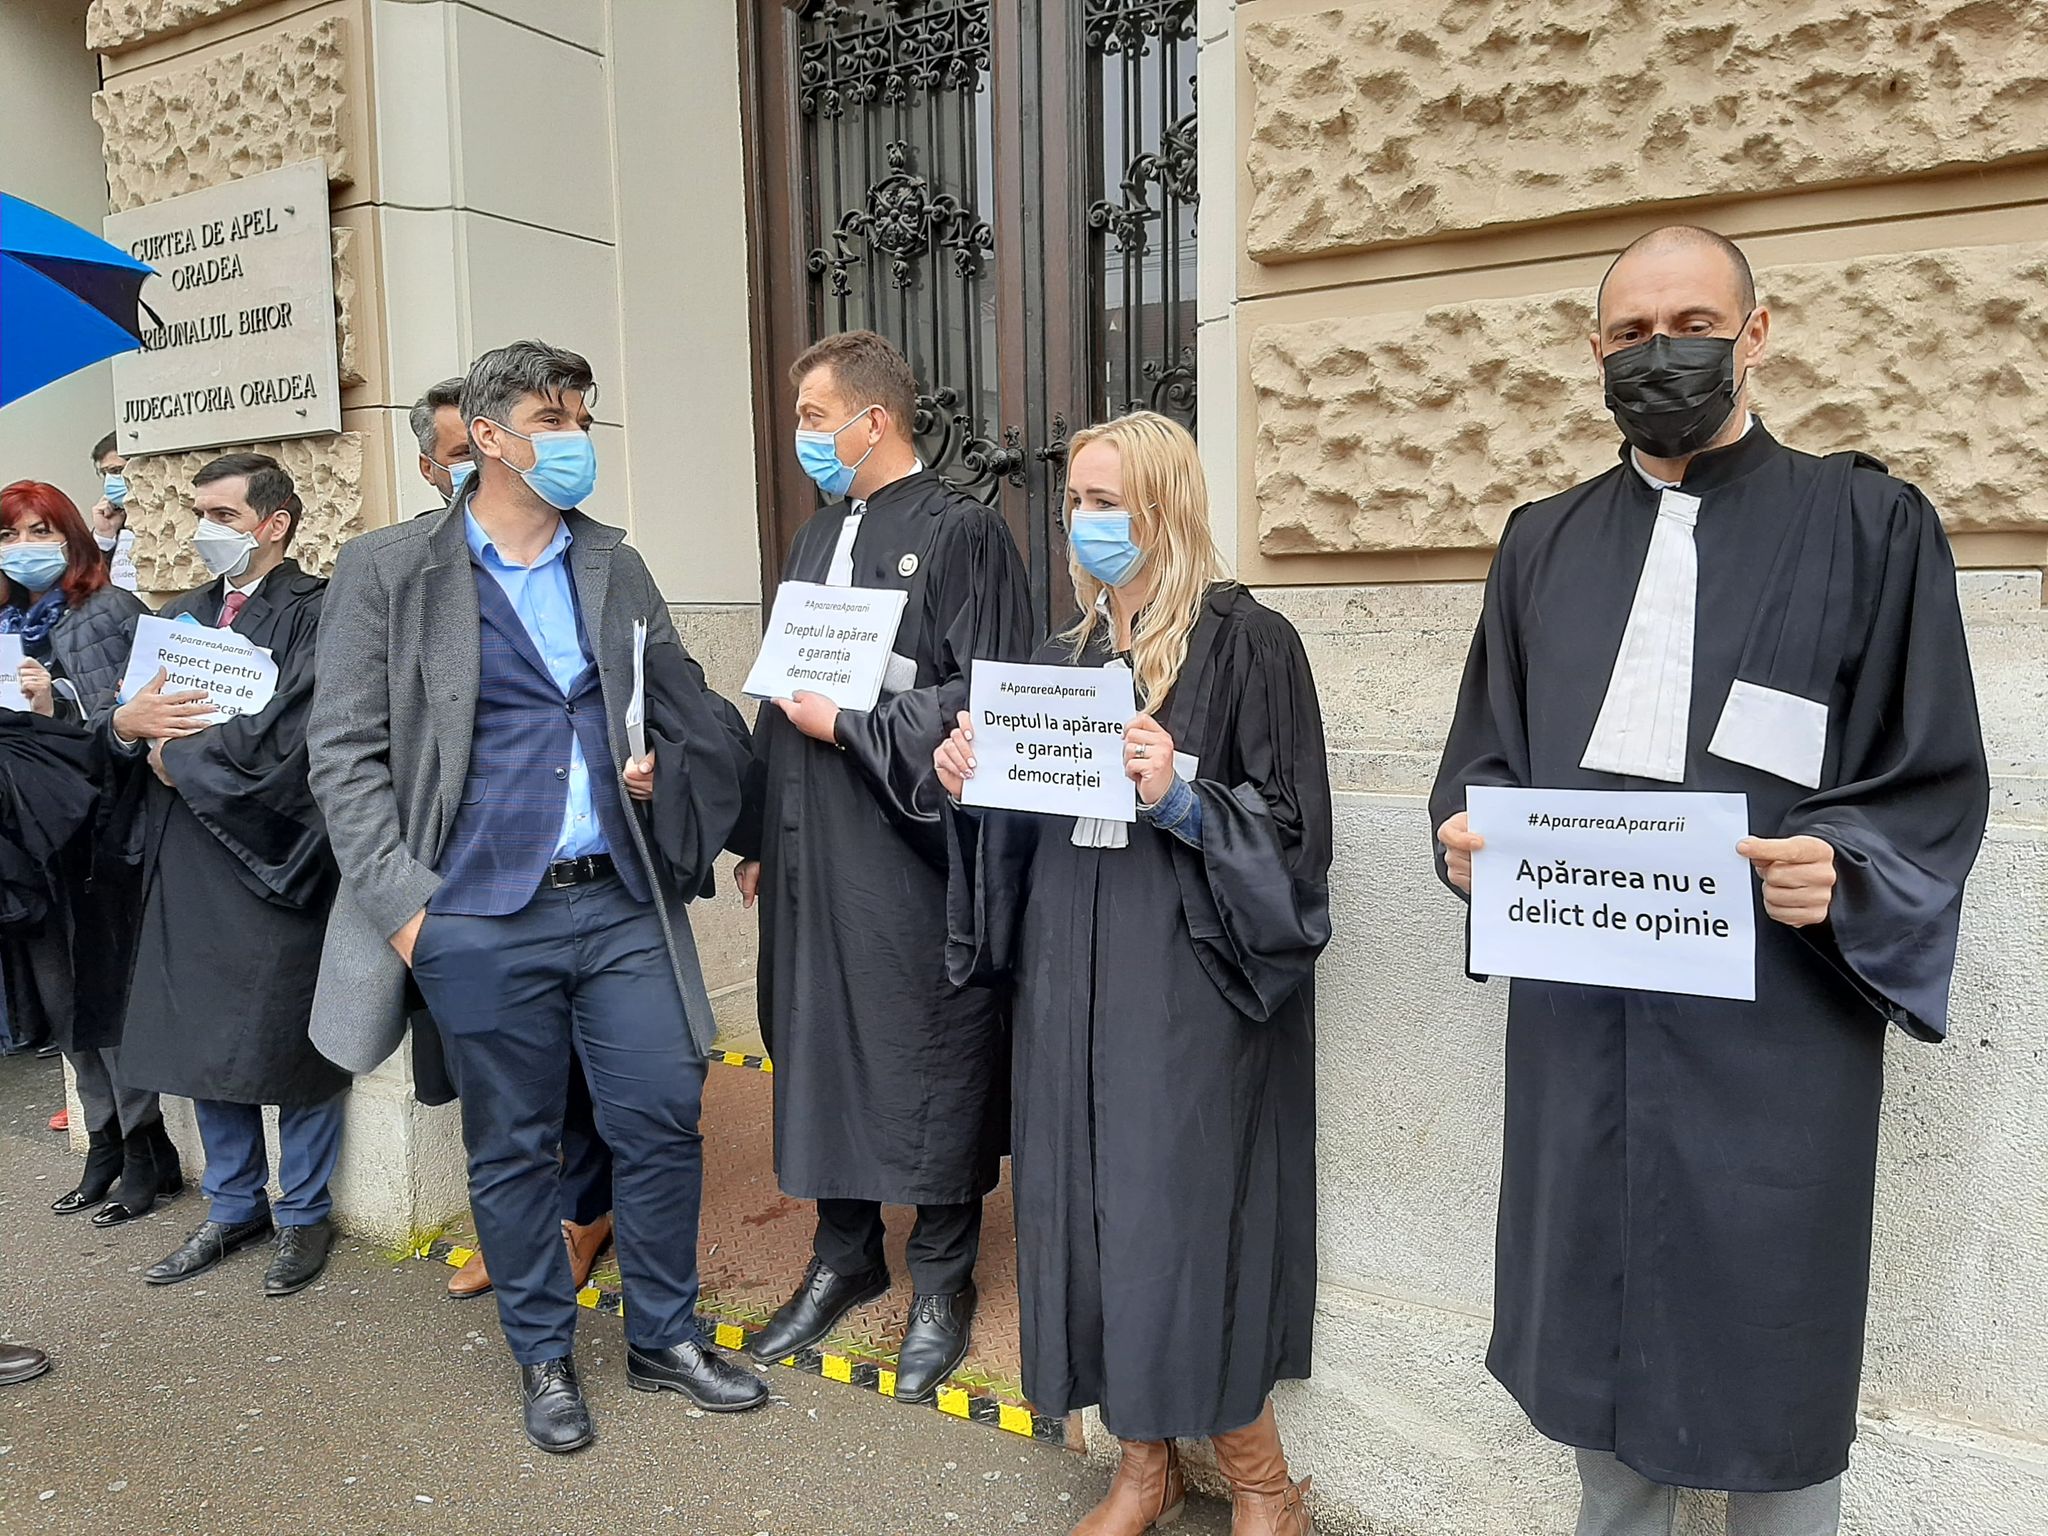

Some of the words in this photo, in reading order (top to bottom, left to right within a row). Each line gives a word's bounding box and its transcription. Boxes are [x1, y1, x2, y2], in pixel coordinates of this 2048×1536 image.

[131, 228, 197, 263] CURTEA
[201, 220, 226, 249] DE
[229, 207, 279, 241] APEL
[172, 254, 243, 291] ORADEA
[239, 301, 293, 336] BIHOR
[123, 386, 236, 423] JUDECATORIA
[239, 373, 318, 407] ORADEA
[784, 622, 824, 639] Dreptul
[826, 625, 836, 639] la
[837, 627, 878, 643] apărare
[157, 648, 211, 670] Respect
[212, 663, 263, 681] pentru
[798, 646, 805, 656] e
[165, 671, 233, 696] utoritatea
[235, 684, 254, 699] de
[1000, 682, 1096, 697] #AparareaApararii
[984, 710, 1041, 731] Dreptul
[1045, 715, 1058, 730] la
[1062, 716, 1123, 736] apărare
[1015, 742, 1024, 754] e
[1028, 742, 1093, 763] garanția
[1008, 764, 1101, 792] democrației
[1528, 813, 1685, 834] #AparareaApararii
[1516, 859, 1645, 890] Apărarea
[1653, 872, 1690, 893] nu
[1699, 876, 1716, 895] e
[1508, 897, 1585, 926] delict
[1592, 903, 1627, 930] de
[1635, 909, 1730, 940] opinie
